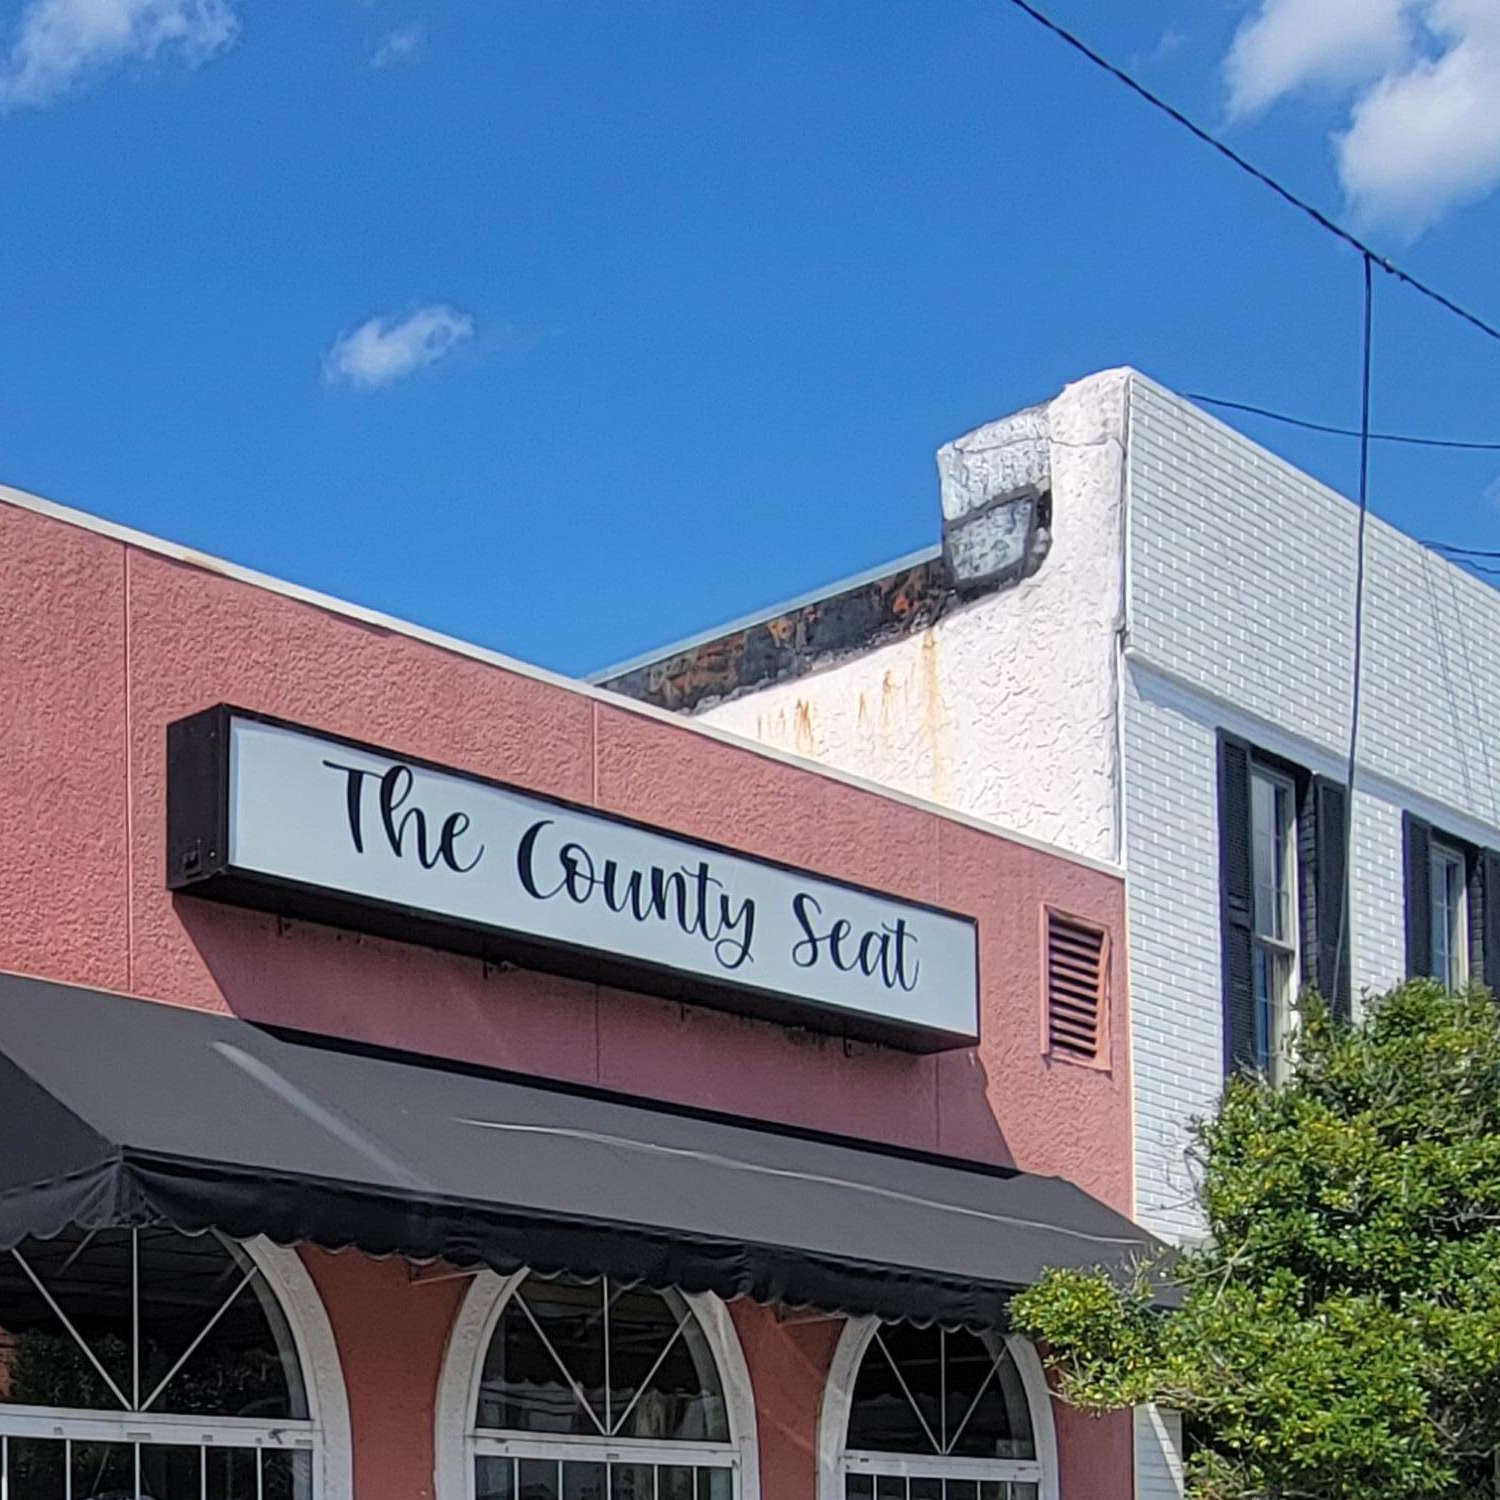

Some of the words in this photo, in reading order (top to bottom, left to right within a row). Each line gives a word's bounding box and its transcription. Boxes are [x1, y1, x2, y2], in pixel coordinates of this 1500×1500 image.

[322, 758, 485, 874] The
[516, 820, 755, 969] County
[792, 892, 920, 992] Seat
